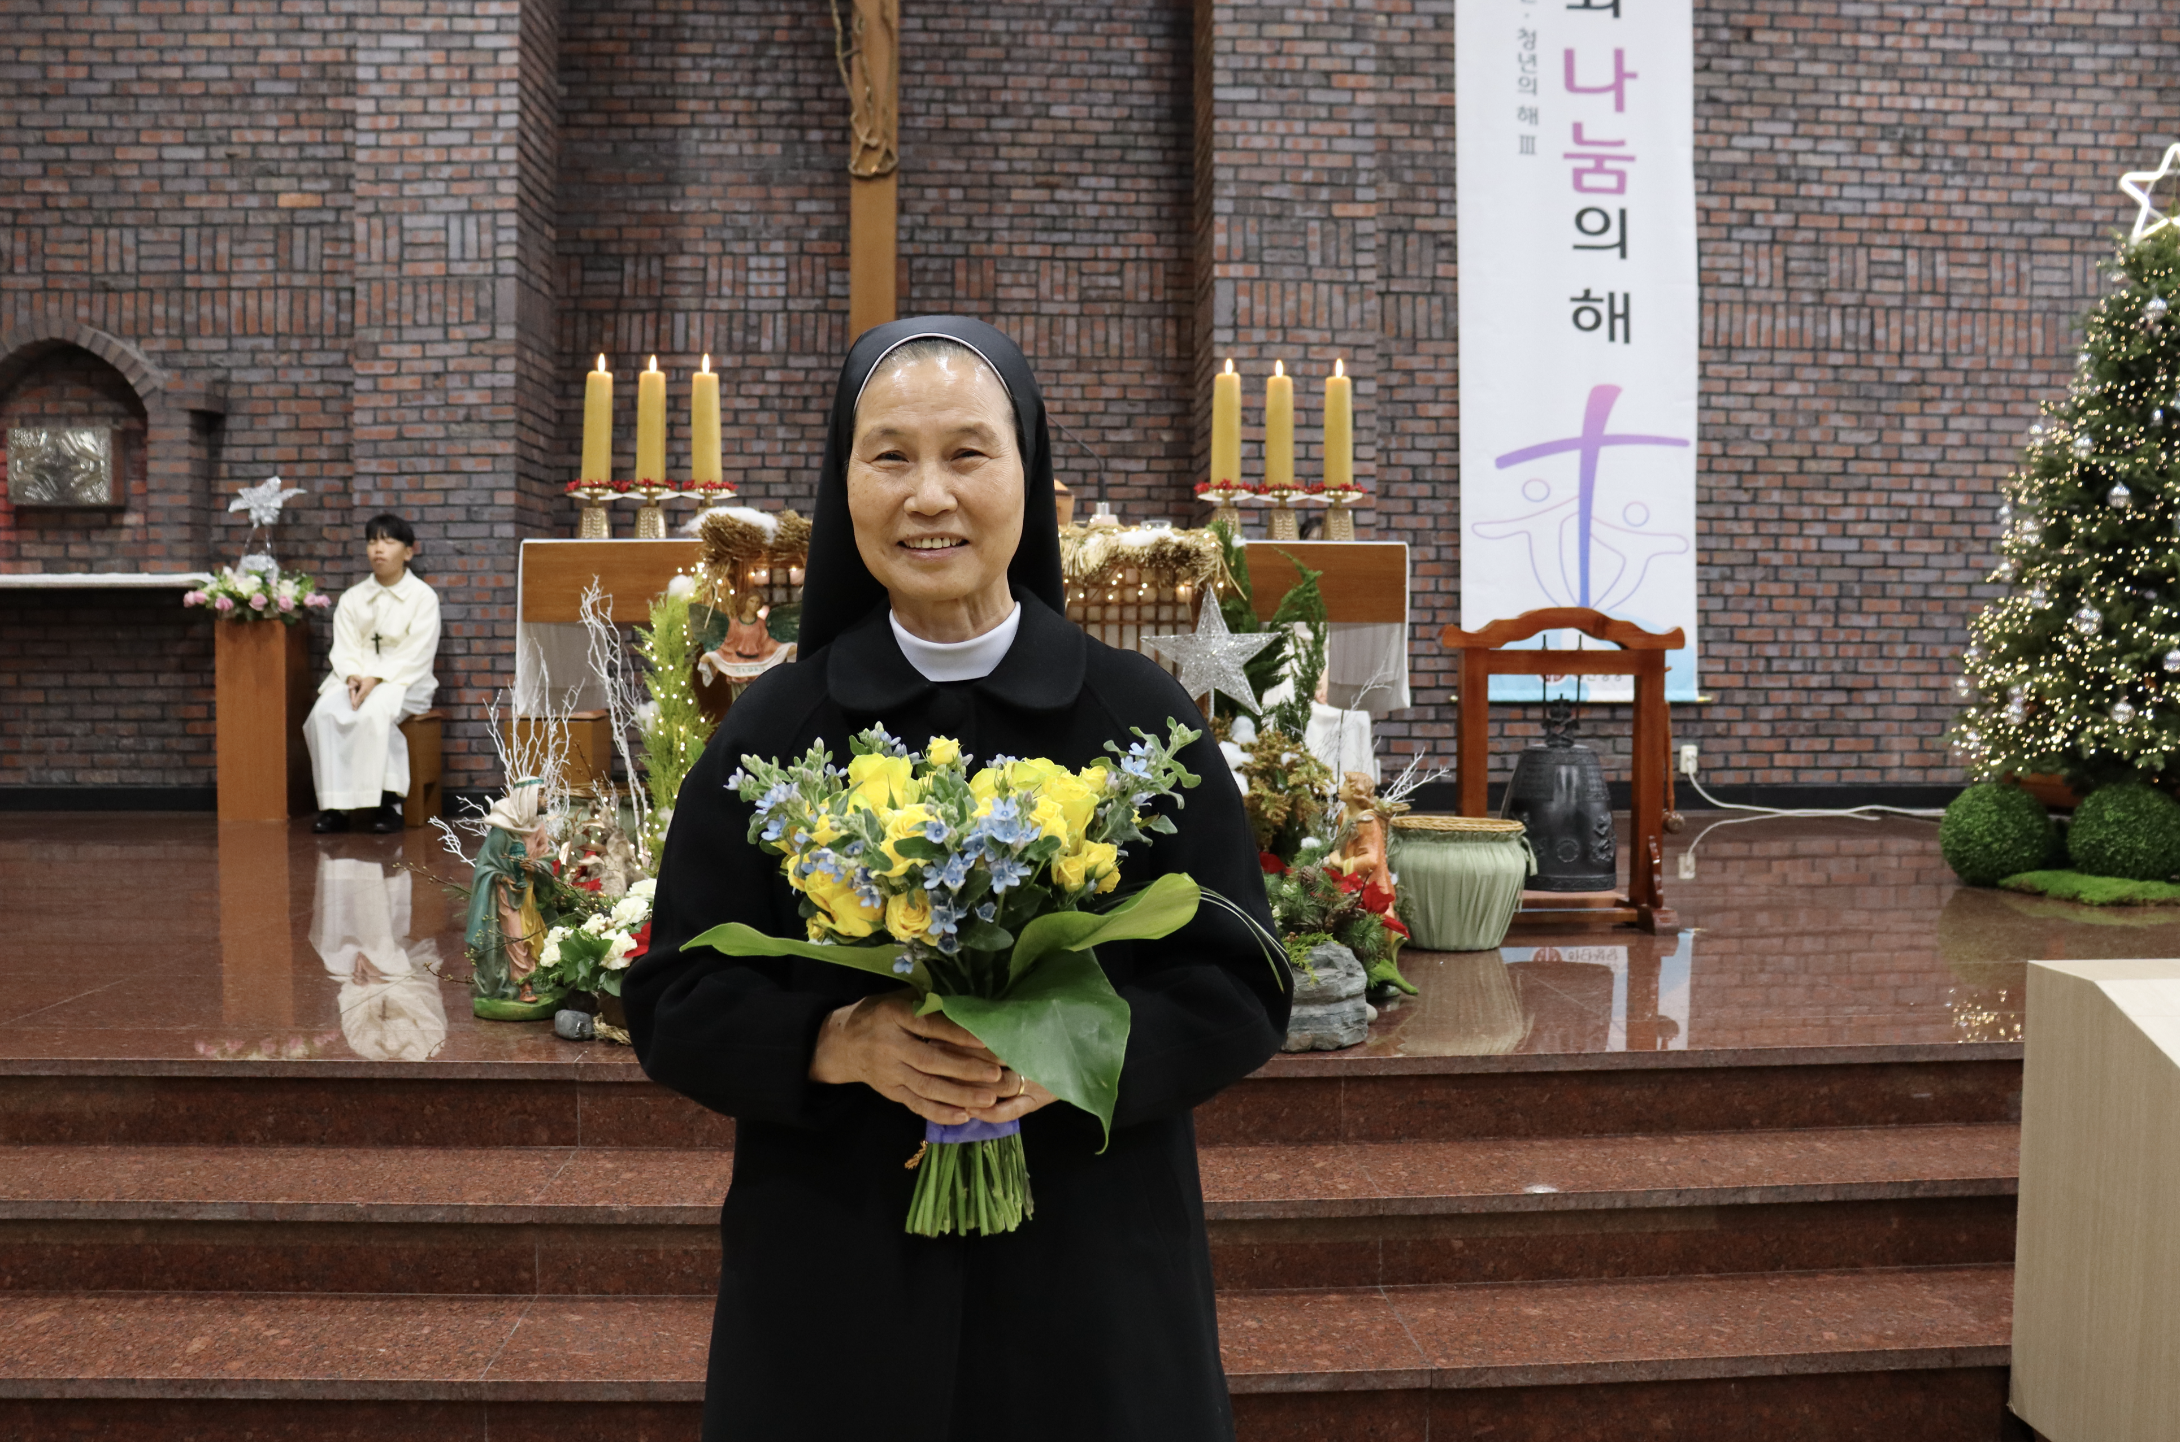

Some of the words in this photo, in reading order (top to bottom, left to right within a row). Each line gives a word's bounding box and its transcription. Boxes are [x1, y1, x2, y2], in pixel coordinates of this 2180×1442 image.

[1517, 28, 1538, 96] 청년의
[1517, 106, 1539, 126] 해
[1562, 47, 1638, 260] 나눔의
[1569, 287, 1631, 345] 해
